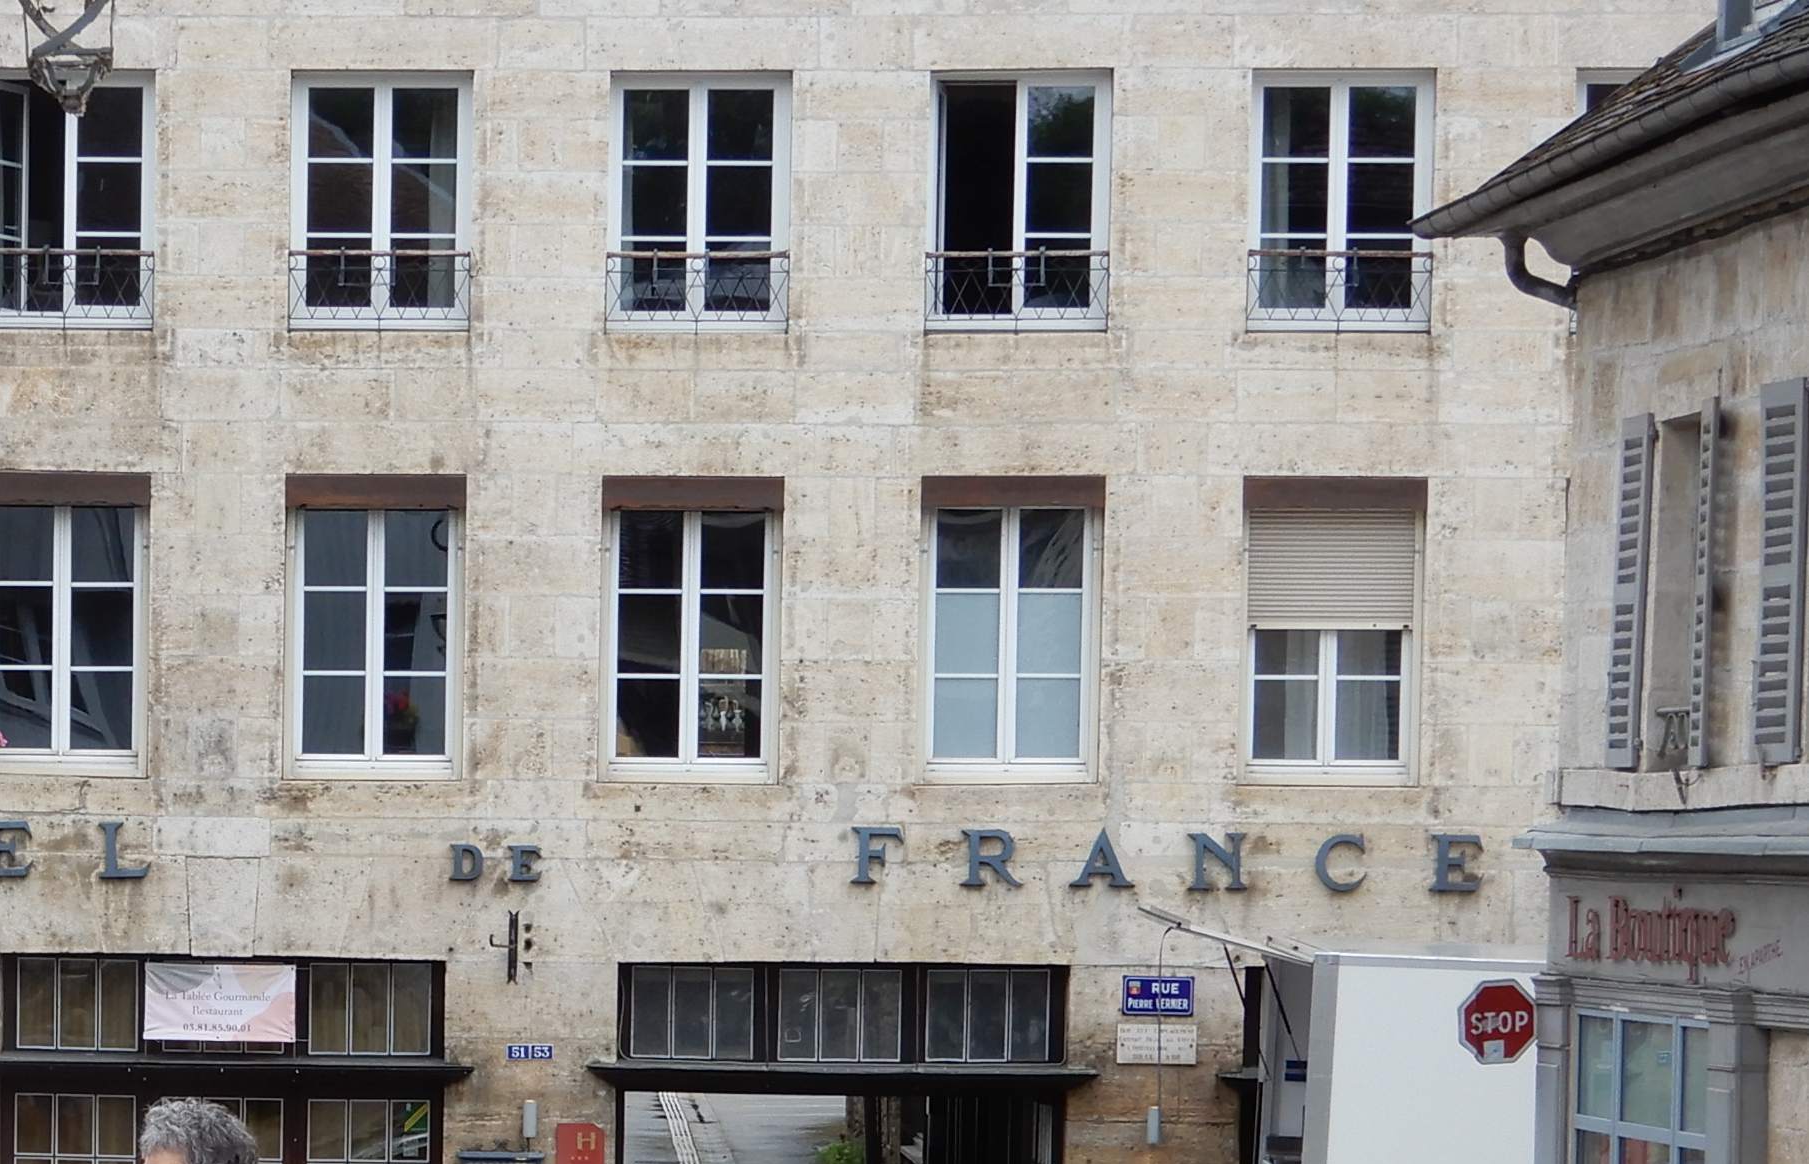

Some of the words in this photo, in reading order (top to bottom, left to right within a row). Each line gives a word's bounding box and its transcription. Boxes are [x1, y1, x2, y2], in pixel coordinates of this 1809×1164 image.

[448, 843, 543, 882] DE
[849, 825, 1484, 894] FRANCE
[1565, 895, 1602, 962] La
[1607, 883, 1736, 984] Boutique
[1151, 982, 1180, 994] RUE
[1127, 997, 1154, 1010] PIERRE
[1156, 998, 1189, 1010] VERNIER
[192, 1005, 244, 1016] Restaurant
[182, 1023, 252, 1033] 03.81.85.90.01
[1470, 1010, 1529, 1036] STOP
[511, 1046, 526, 1058] 51
[533, 1046, 550, 1058] 53
